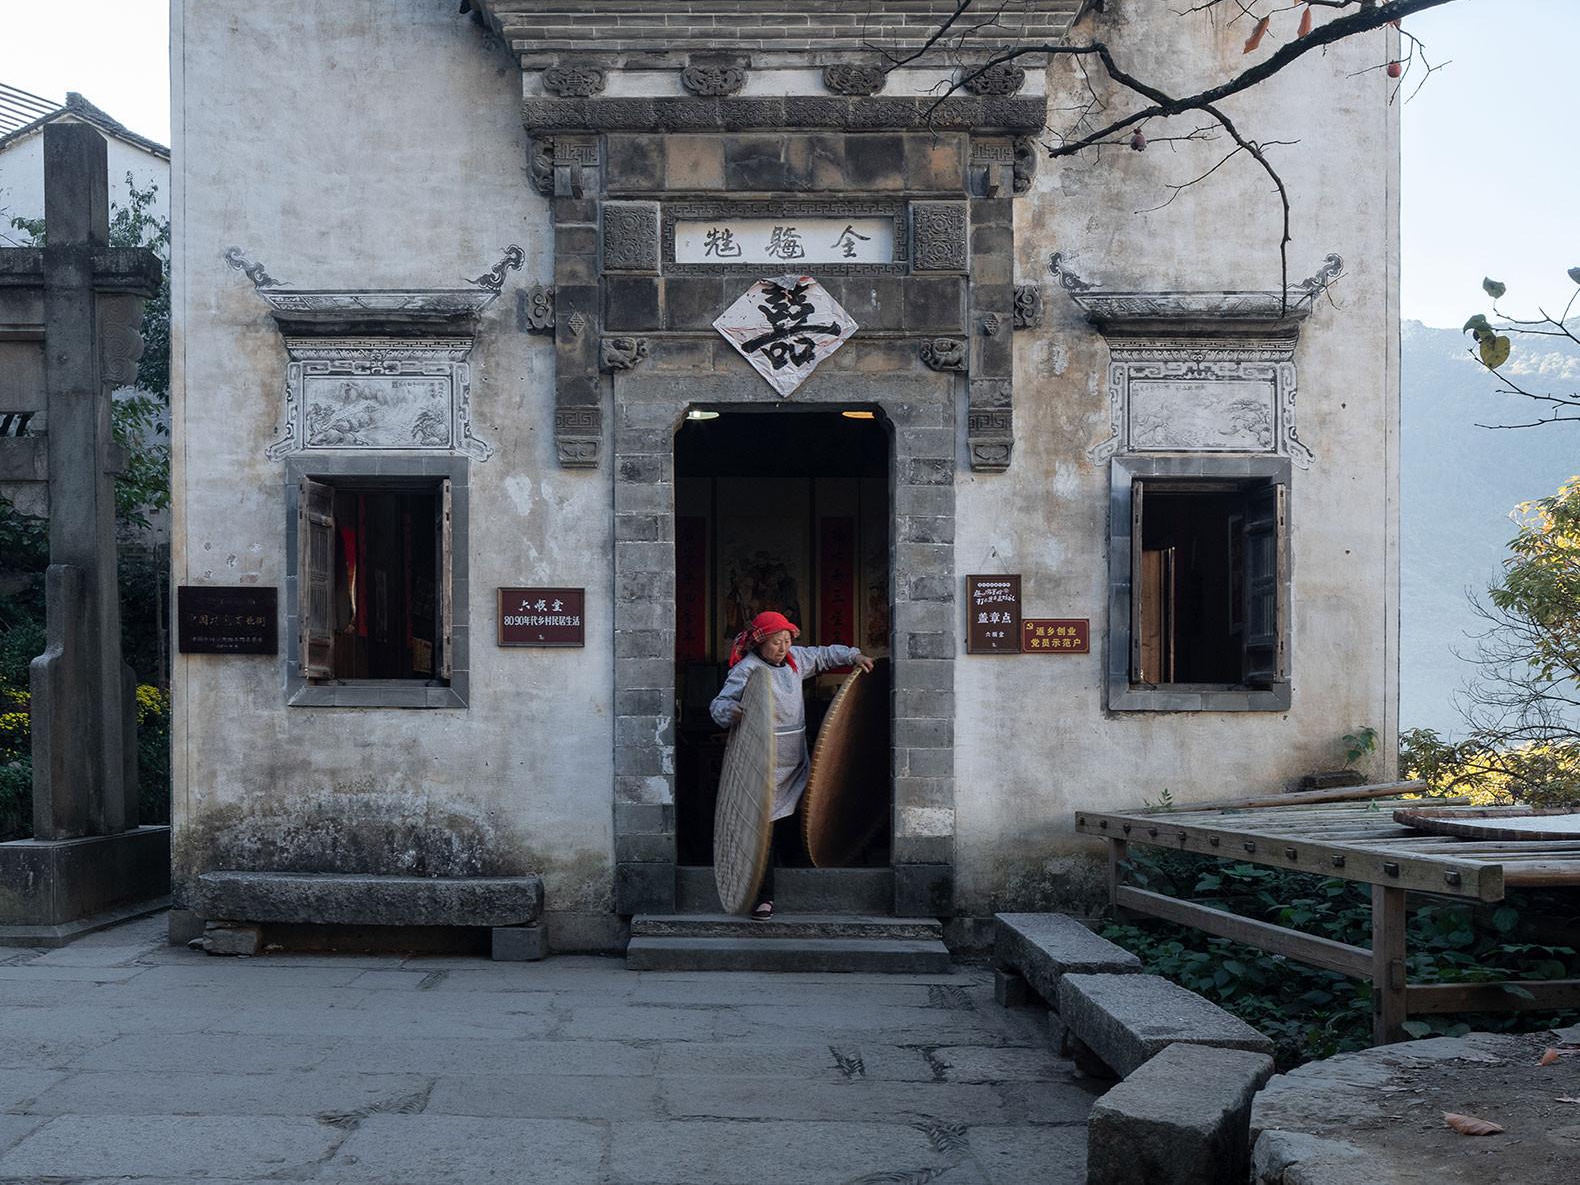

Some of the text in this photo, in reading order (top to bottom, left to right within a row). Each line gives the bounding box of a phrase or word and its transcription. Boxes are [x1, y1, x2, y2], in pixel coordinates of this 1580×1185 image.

[977, 612, 1012, 624] 盖章点
[1035, 627, 1076, 636] 返乡创业
[1030, 638, 1081, 648] 党员示范户
